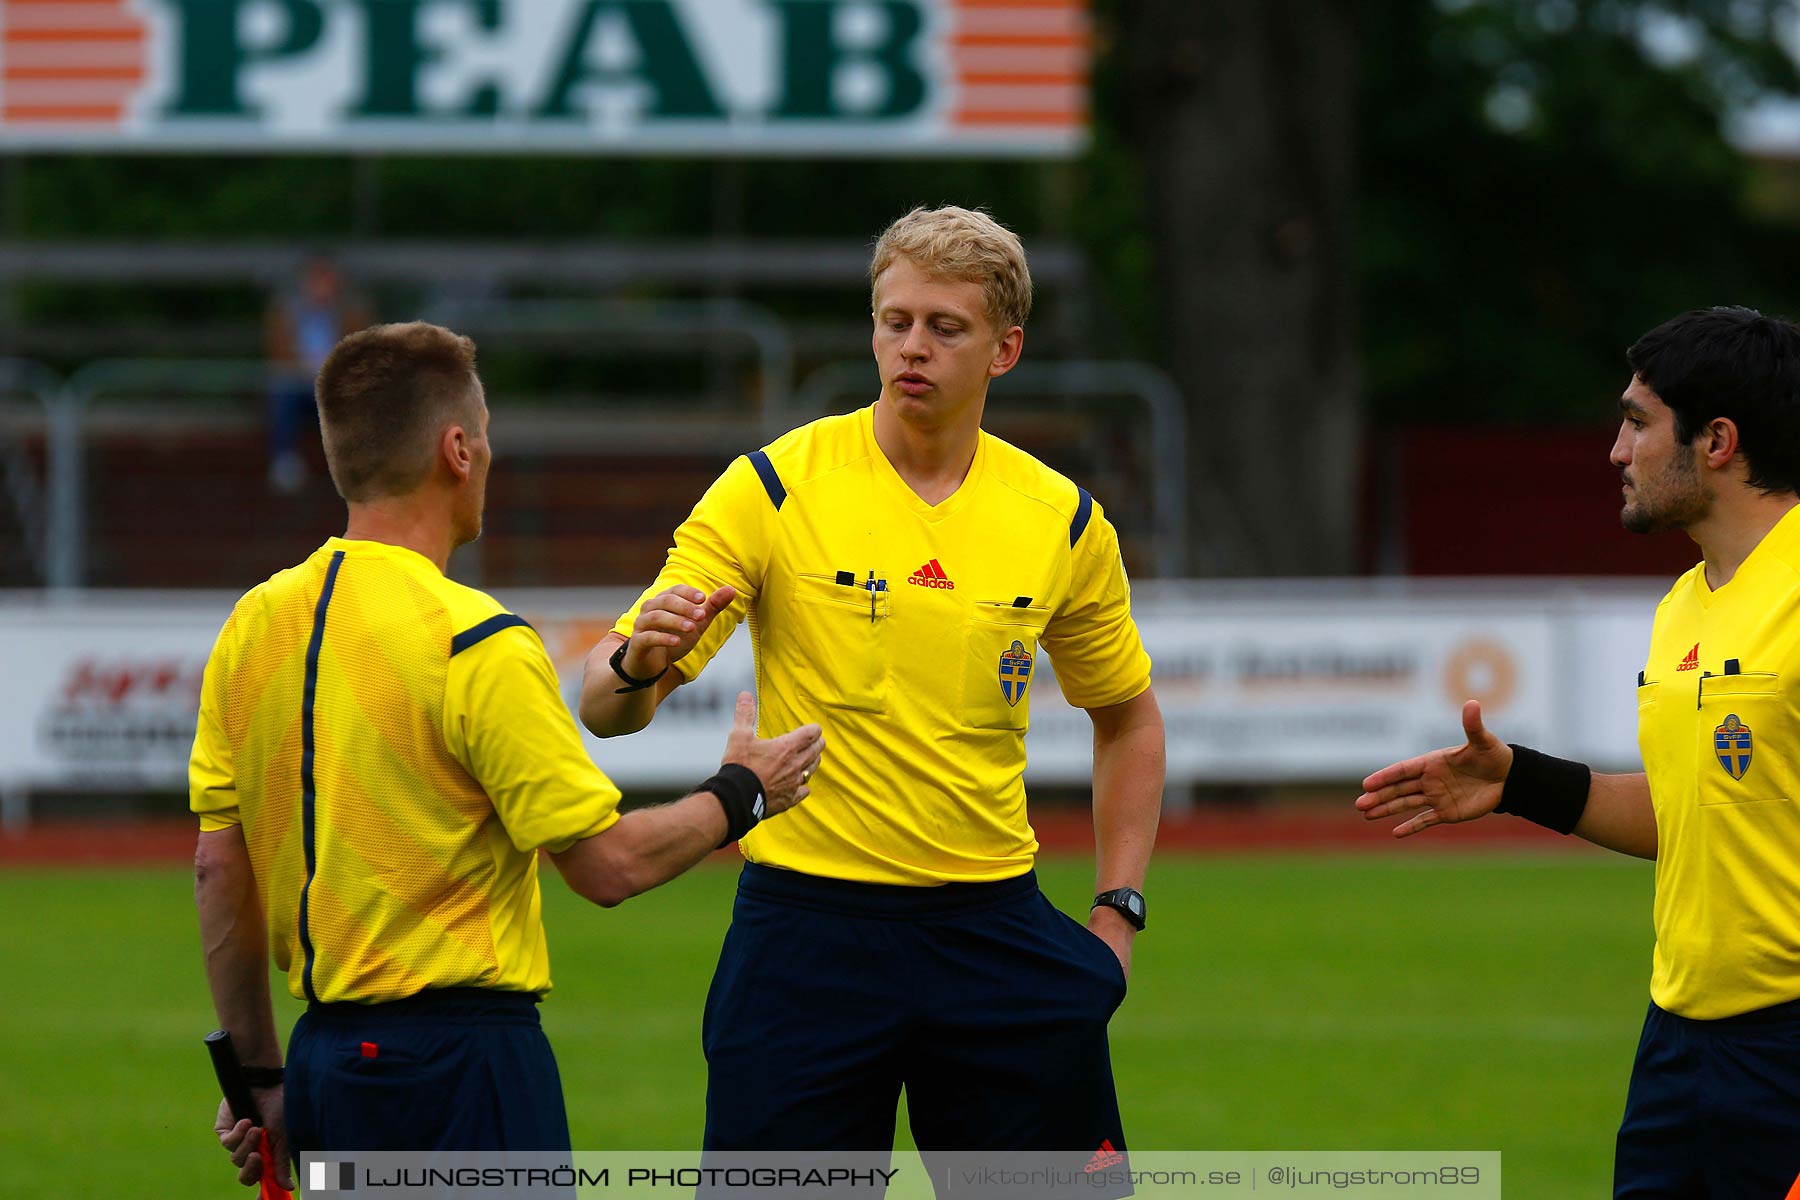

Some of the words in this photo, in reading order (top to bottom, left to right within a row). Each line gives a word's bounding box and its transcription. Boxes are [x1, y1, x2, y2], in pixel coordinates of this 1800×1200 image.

[160, 0, 930, 119] PEAB
[907, 576, 955, 590] adidas
[1084, 1154, 1124, 1173] adidas
